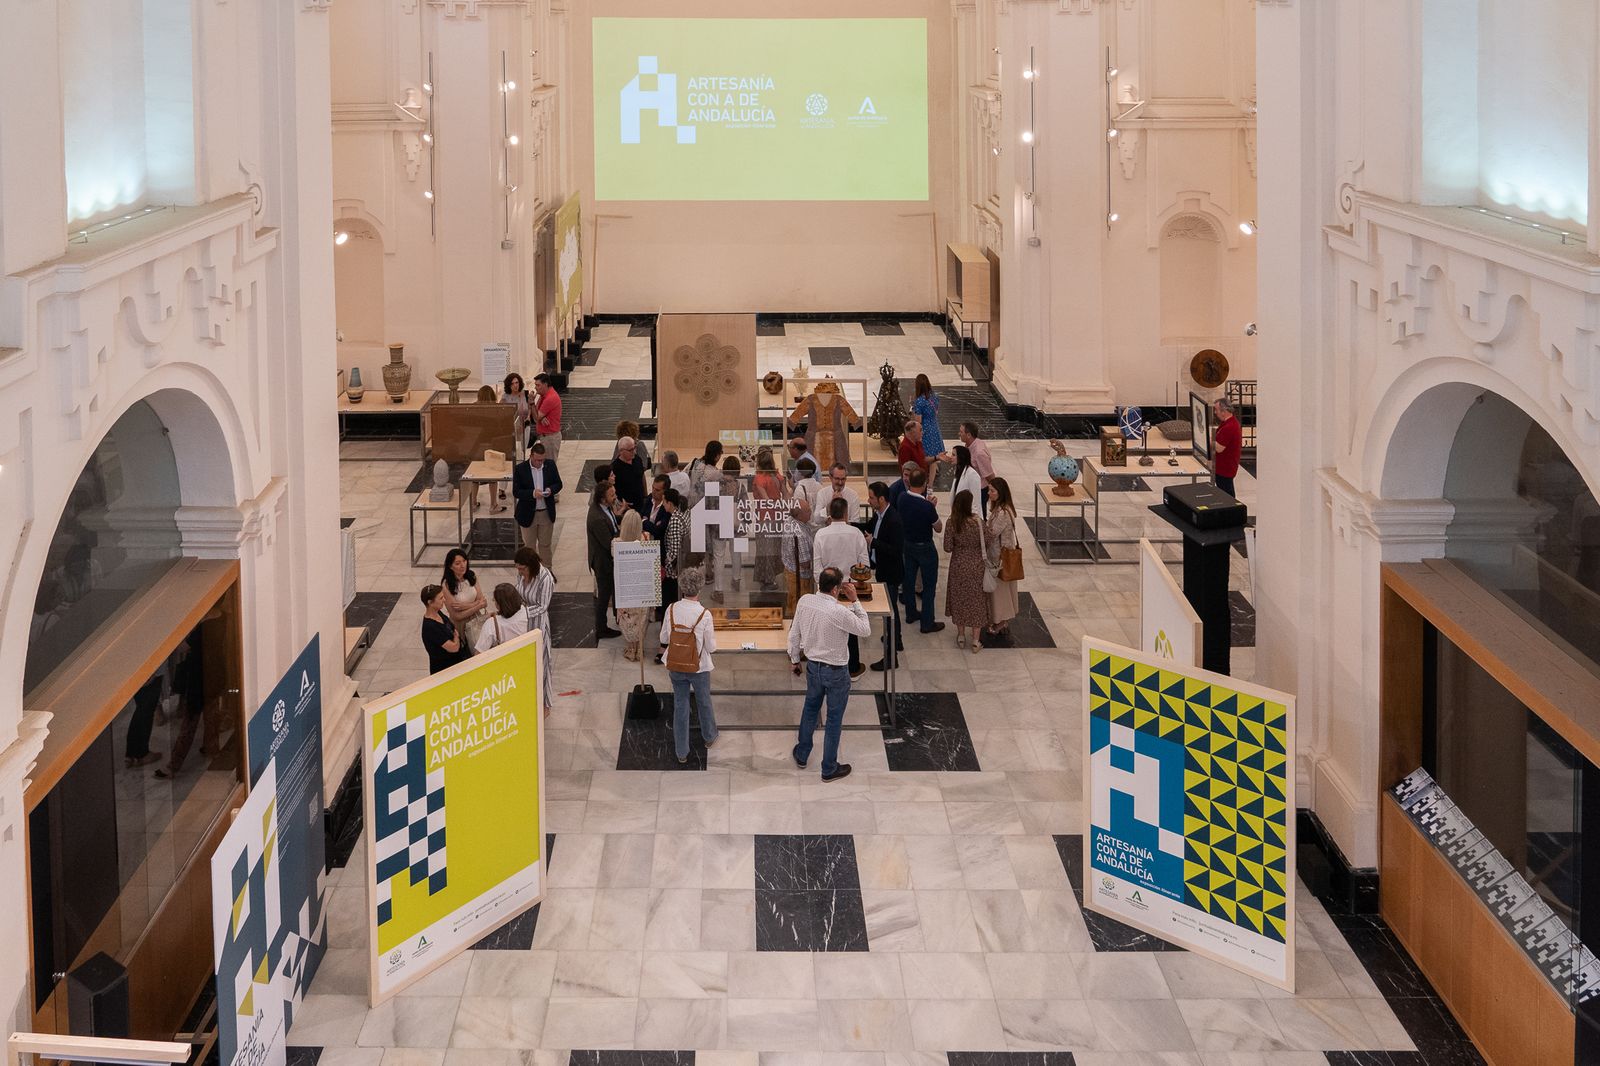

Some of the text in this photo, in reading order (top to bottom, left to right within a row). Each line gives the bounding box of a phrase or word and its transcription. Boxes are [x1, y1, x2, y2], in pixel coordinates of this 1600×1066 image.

[687, 73, 776, 91] ARTESANÍA
[687, 93, 760, 106] CON A DE
[687, 105, 776, 122] ANDALUCÍA
[737, 496, 801, 509] ARTESANÍA
[737, 511, 790, 521] CON A DE
[737, 520, 802, 533] ANDALUCÍA
[618, 548, 658, 556] HERRAMIENTAS
[429, 673, 517, 729] ARTESANÍA
[429, 700, 502, 747] CON A DE
[429, 712, 518, 769] ANDALUCÍA
[1096, 832, 1154, 862] ARTESANÍA
[1096, 842, 1143, 868] CON A DE
[1096, 853, 1154, 882] ANDALUCÍA
